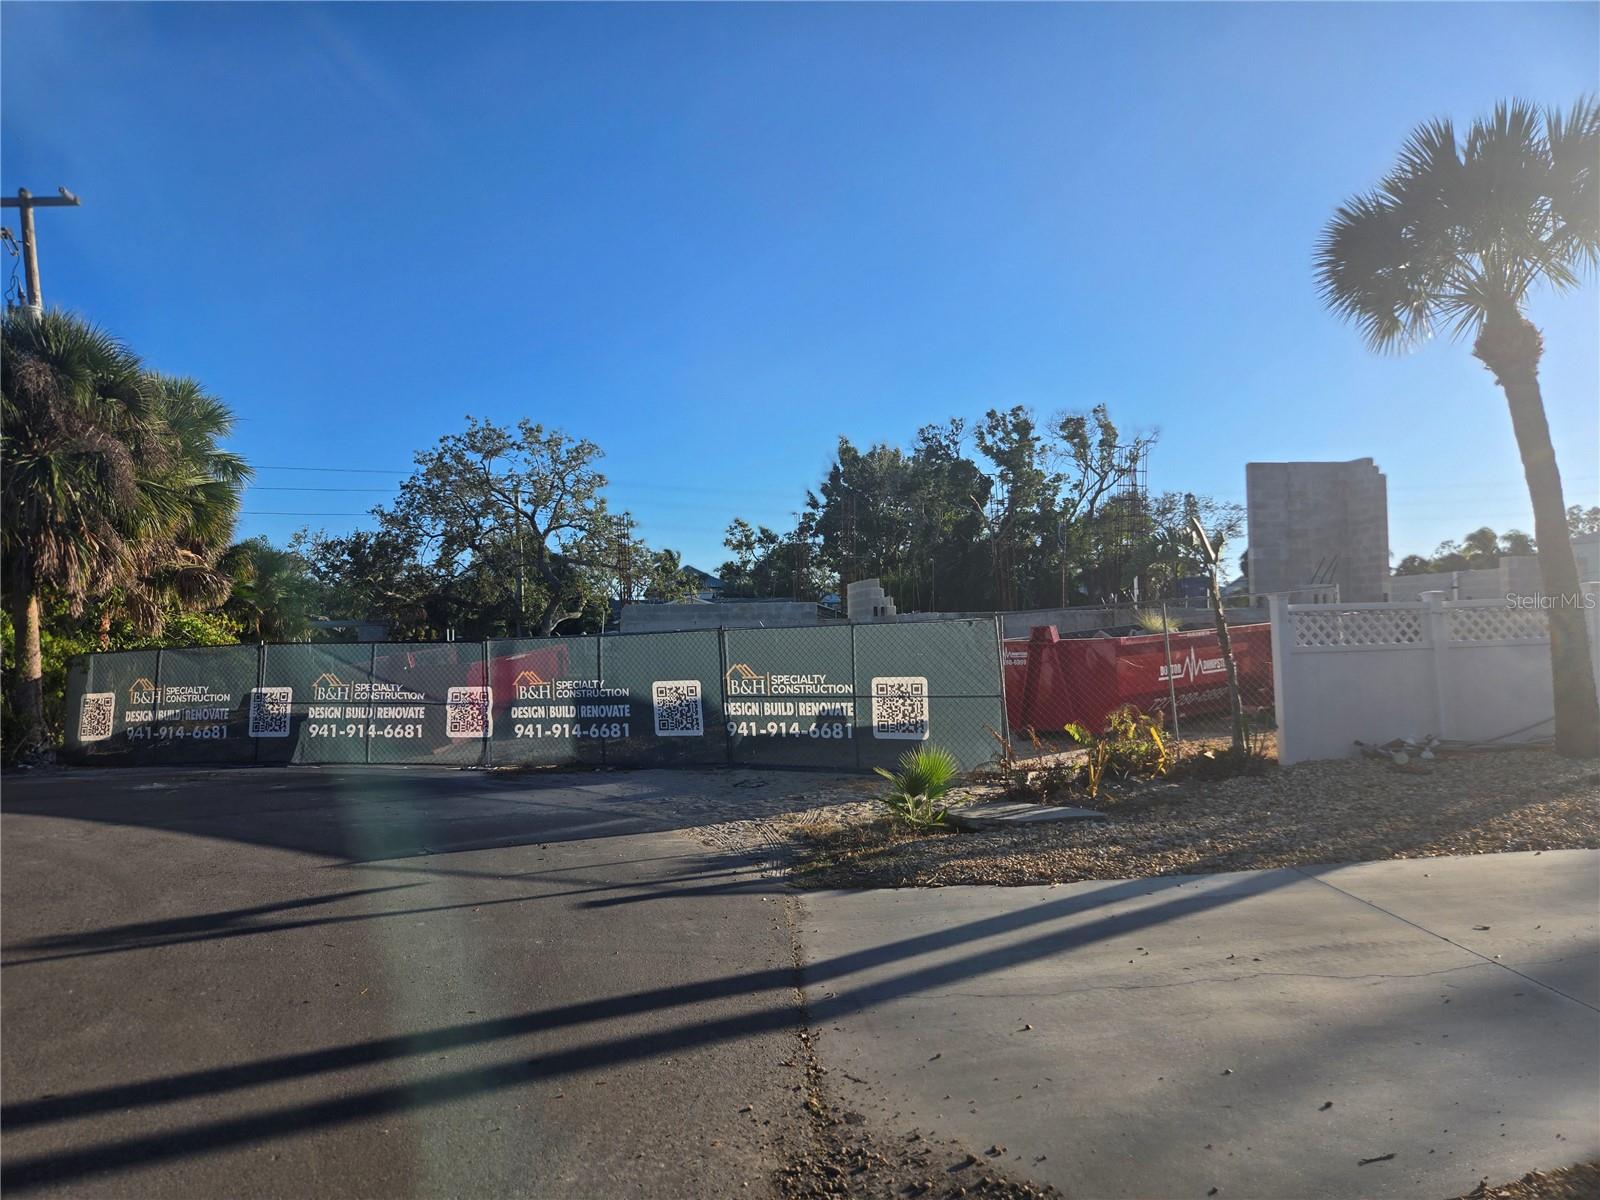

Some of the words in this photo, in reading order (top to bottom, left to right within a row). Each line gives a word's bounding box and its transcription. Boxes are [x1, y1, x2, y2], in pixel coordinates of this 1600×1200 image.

[1160, 663, 1182, 676] DOTOR
[556, 680, 605, 690] SPECIALTY
[771, 674, 827, 685] SPECIALTY
[166, 686, 209, 695] SPECIALTY
[354, 683, 403, 692] SPECIALTY
[519, 685, 551, 700] B&H
[556, 688, 630, 698] CONSTRUCTION
[731, 679, 766, 695] B&H
[771, 684, 853, 694] CONSTRUCTION
[133, 691, 162, 704] B&H
[166, 694, 231, 703] CONSTRUCTION
[317, 687, 349, 701] B&H
[354, 691, 425, 700] CONSTRUCTION
[159, 709, 181, 720] BUILD
[186, 708, 229, 720] RENOVATE
[308, 707, 341, 719] DESIGN
[345, 707, 373, 719] BUILD
[377, 707, 425, 719] RENOVATE
[511, 706, 545, 719] DESIGN
[550, 705, 577, 718] BUILD
[581, 704, 631, 717] RENOVATE
[764, 702, 794, 716] BUILD
[799, 702, 854, 716] RENOVATE
[127, 725, 228, 739] 941-914-6681
[308, 724, 423, 738] 941-914-6681
[514, 722, 630, 738] 941-914-6681
[726, 721, 853, 739] 941-914-6681
